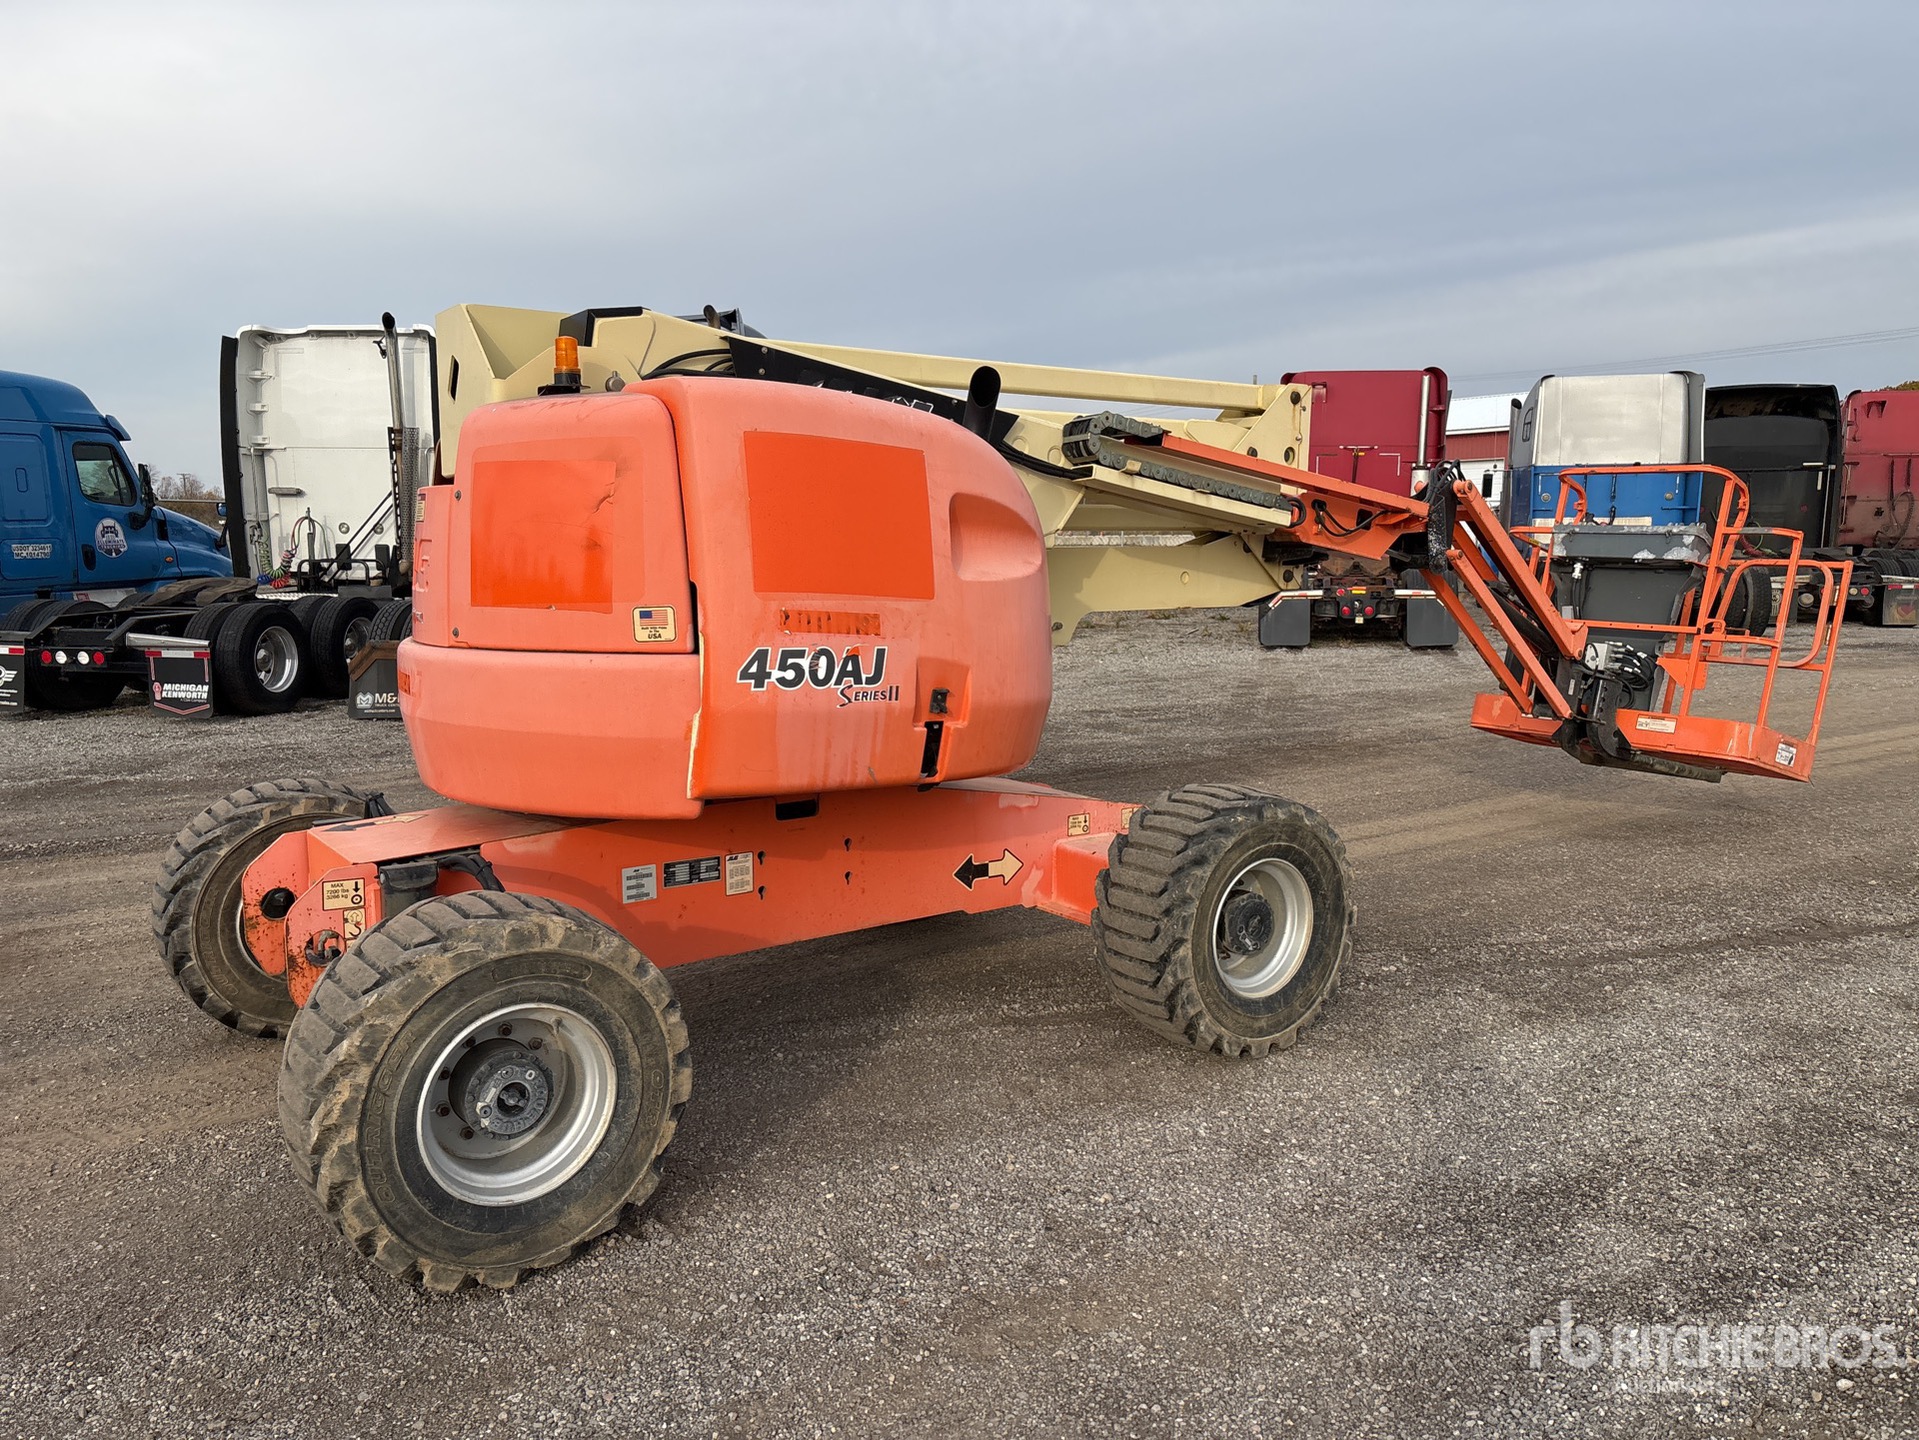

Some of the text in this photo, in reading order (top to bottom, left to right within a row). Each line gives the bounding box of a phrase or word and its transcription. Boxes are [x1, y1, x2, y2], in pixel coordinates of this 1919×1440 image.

[736, 646, 888, 691] 450AJ
[163, 683, 209, 692] MICHIGAN
[162, 690, 208, 699] KENWORTH
